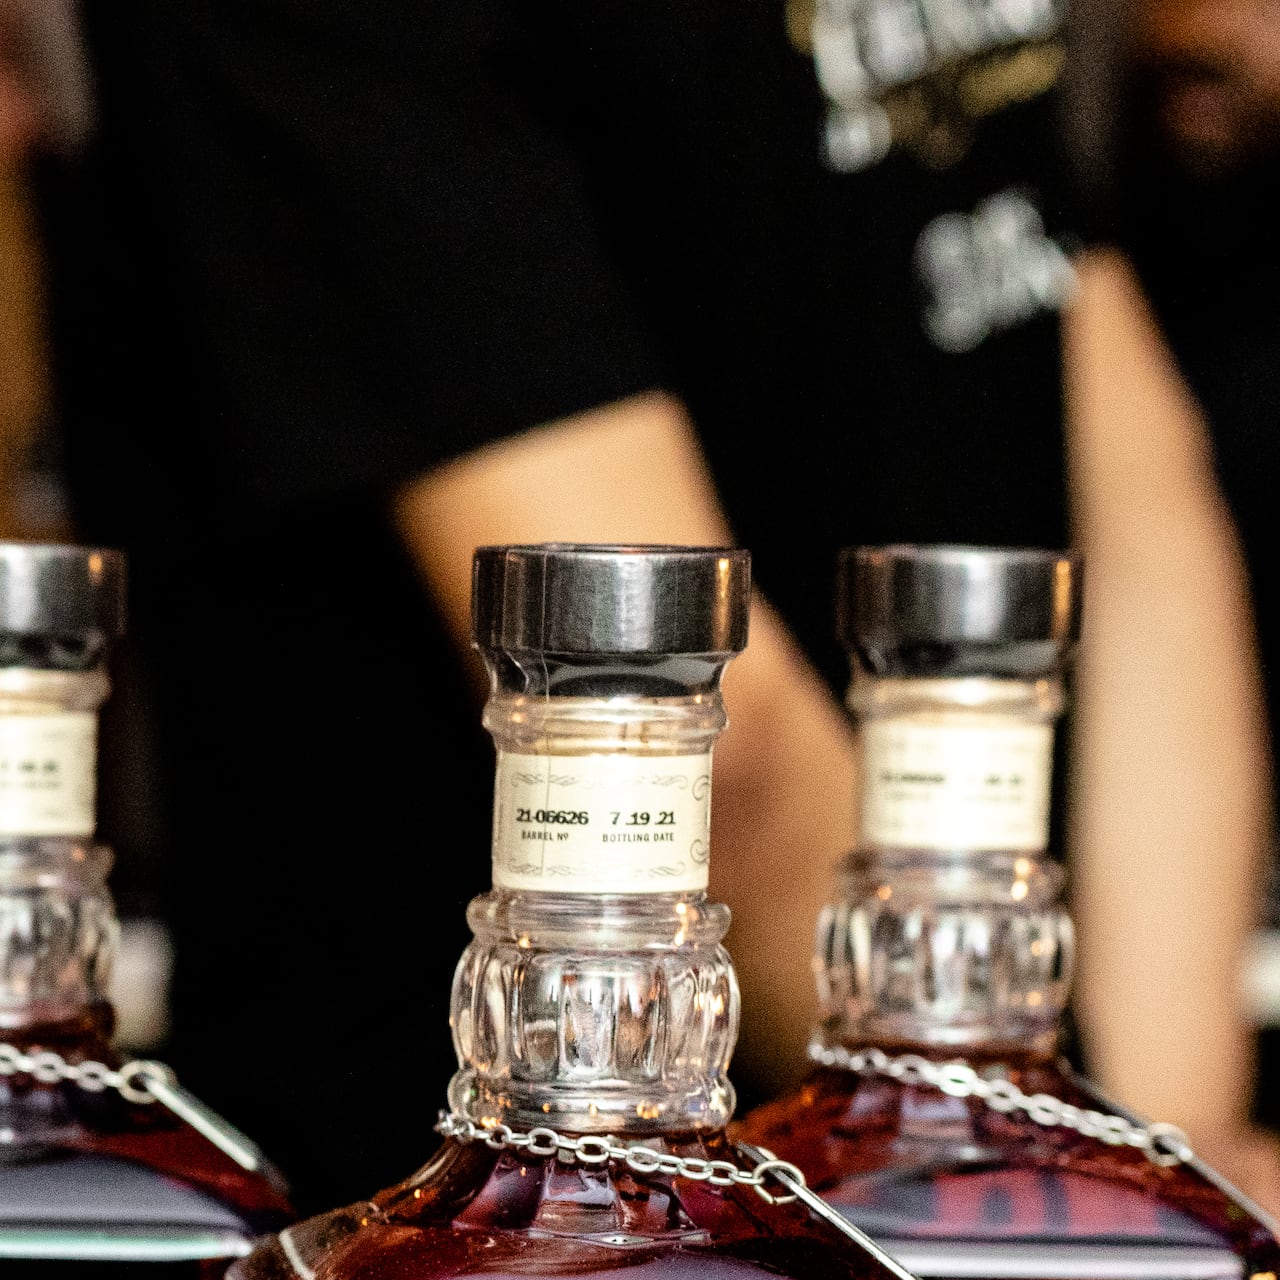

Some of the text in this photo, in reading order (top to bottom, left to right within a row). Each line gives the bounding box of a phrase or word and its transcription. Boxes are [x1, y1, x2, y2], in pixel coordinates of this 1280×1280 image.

[515, 807, 589, 826] 21-06626
[521, 830, 553, 841] BARREL
[602, 832, 674, 842] BOTTLING DATE
